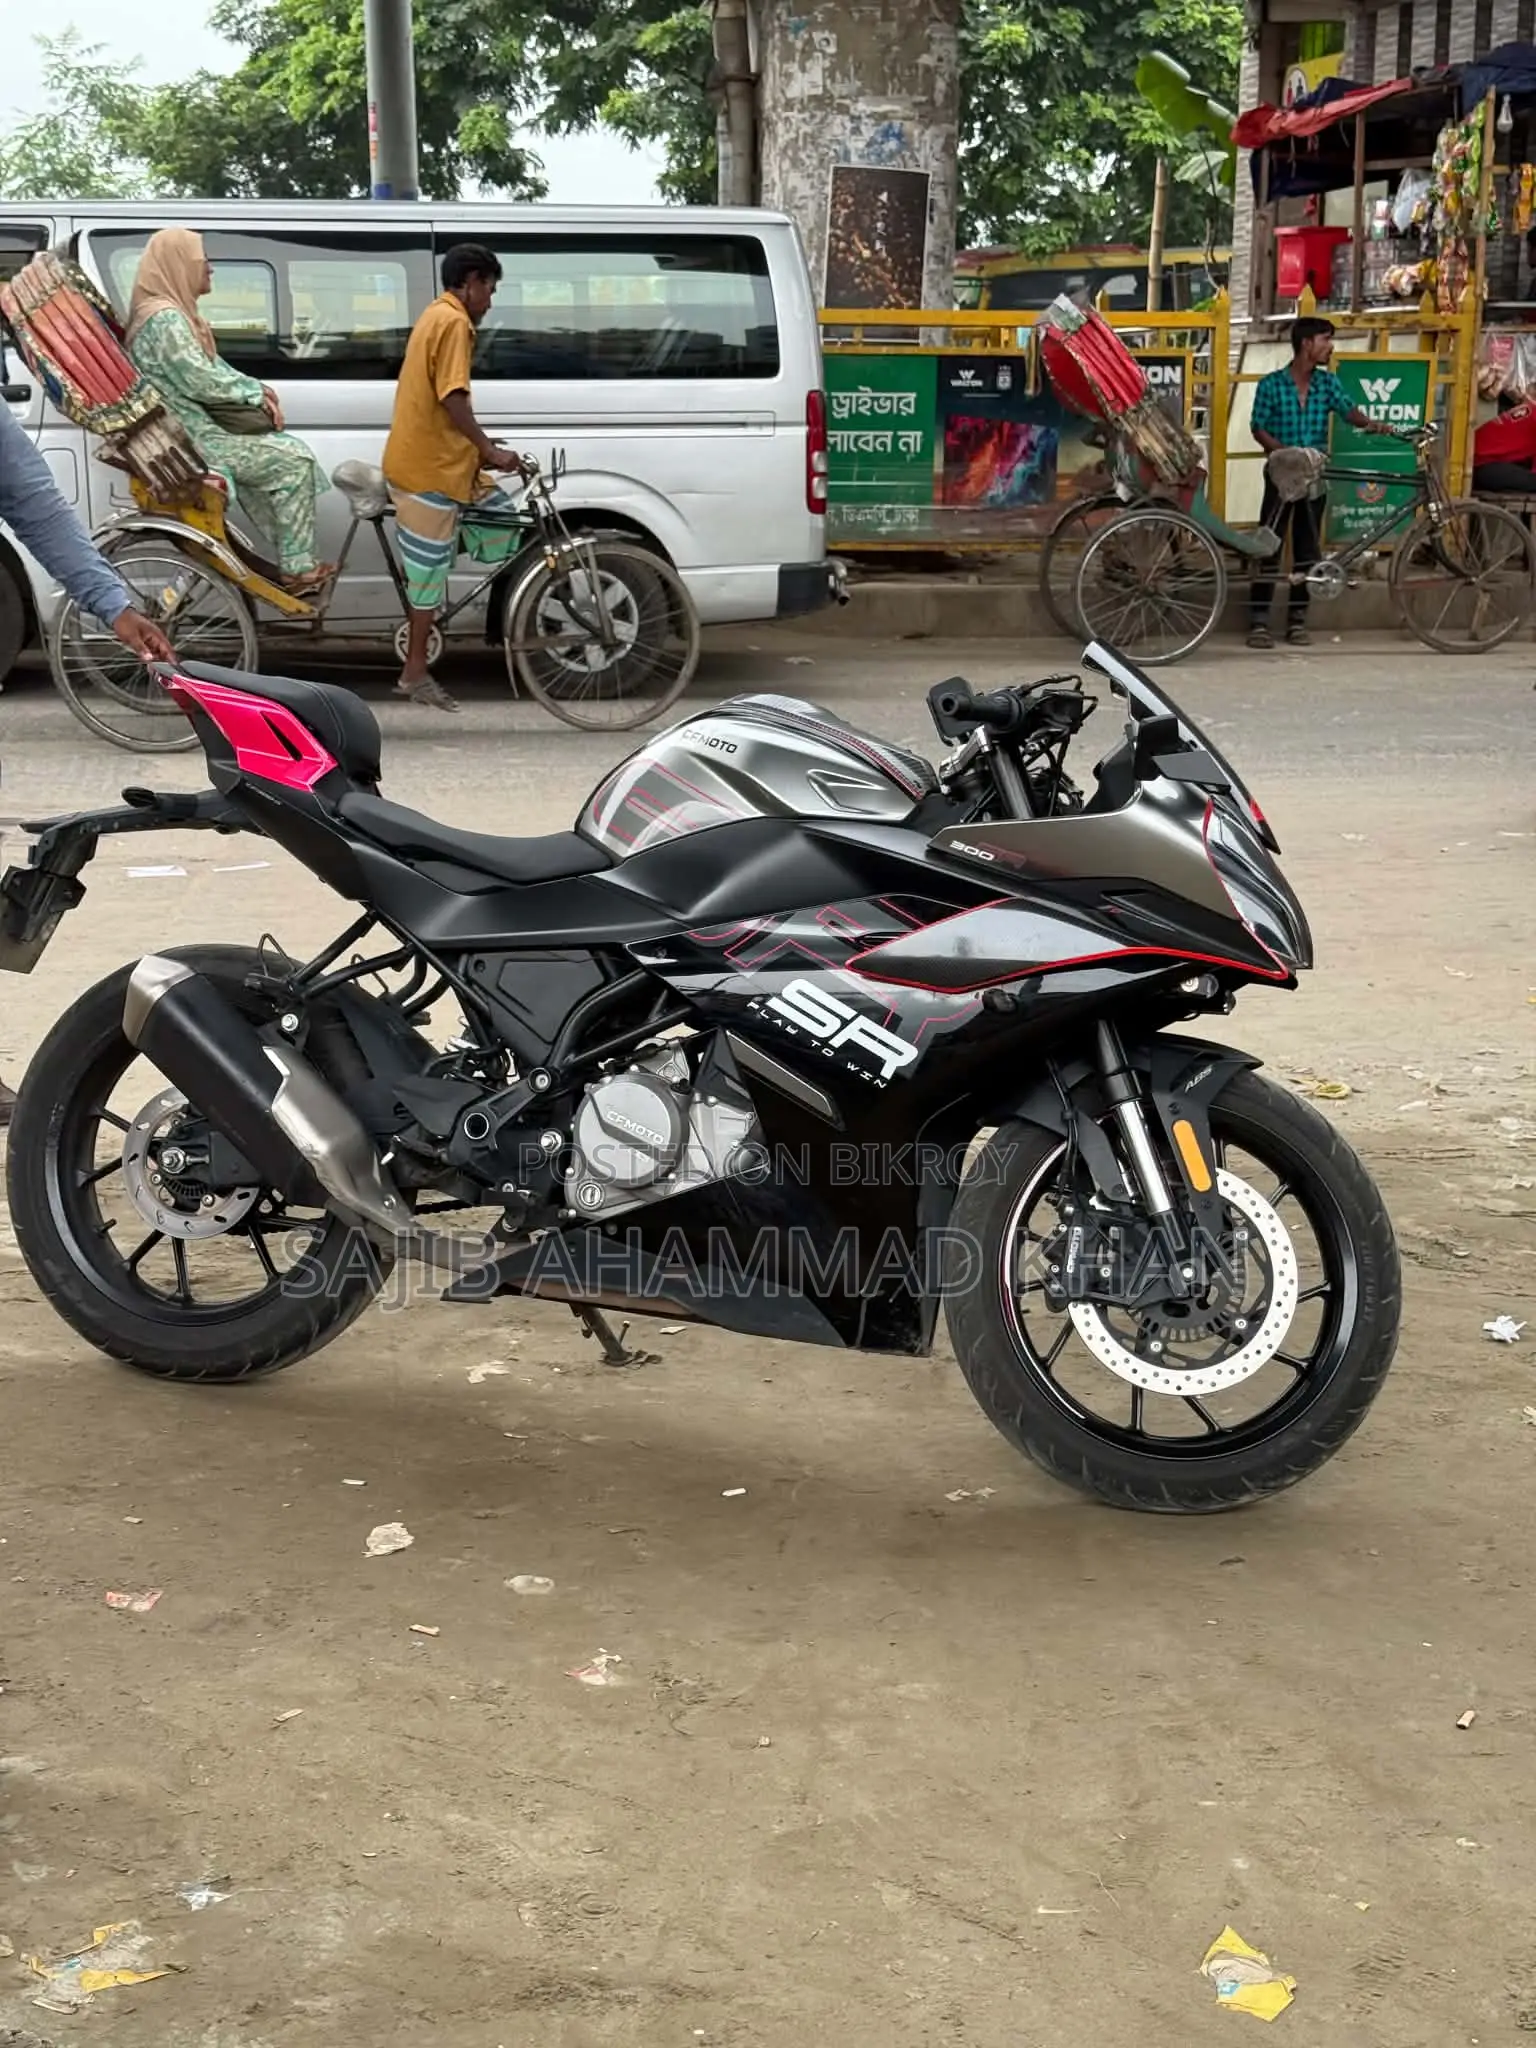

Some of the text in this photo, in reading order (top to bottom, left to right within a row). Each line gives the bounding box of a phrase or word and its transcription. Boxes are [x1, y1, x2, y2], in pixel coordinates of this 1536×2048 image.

[831, 385, 917, 419] ড্রাইভার
[896, 430, 922, 454] না
[682, 729, 738, 754] CFMOTO
[949, 840, 995, 861] 300
[765, 978, 919, 1081] SR
[810, 1039, 835, 1057] TO
[846, 1061, 888, 1089] WIN
[606, 1110, 664, 1144] CFMOTO
